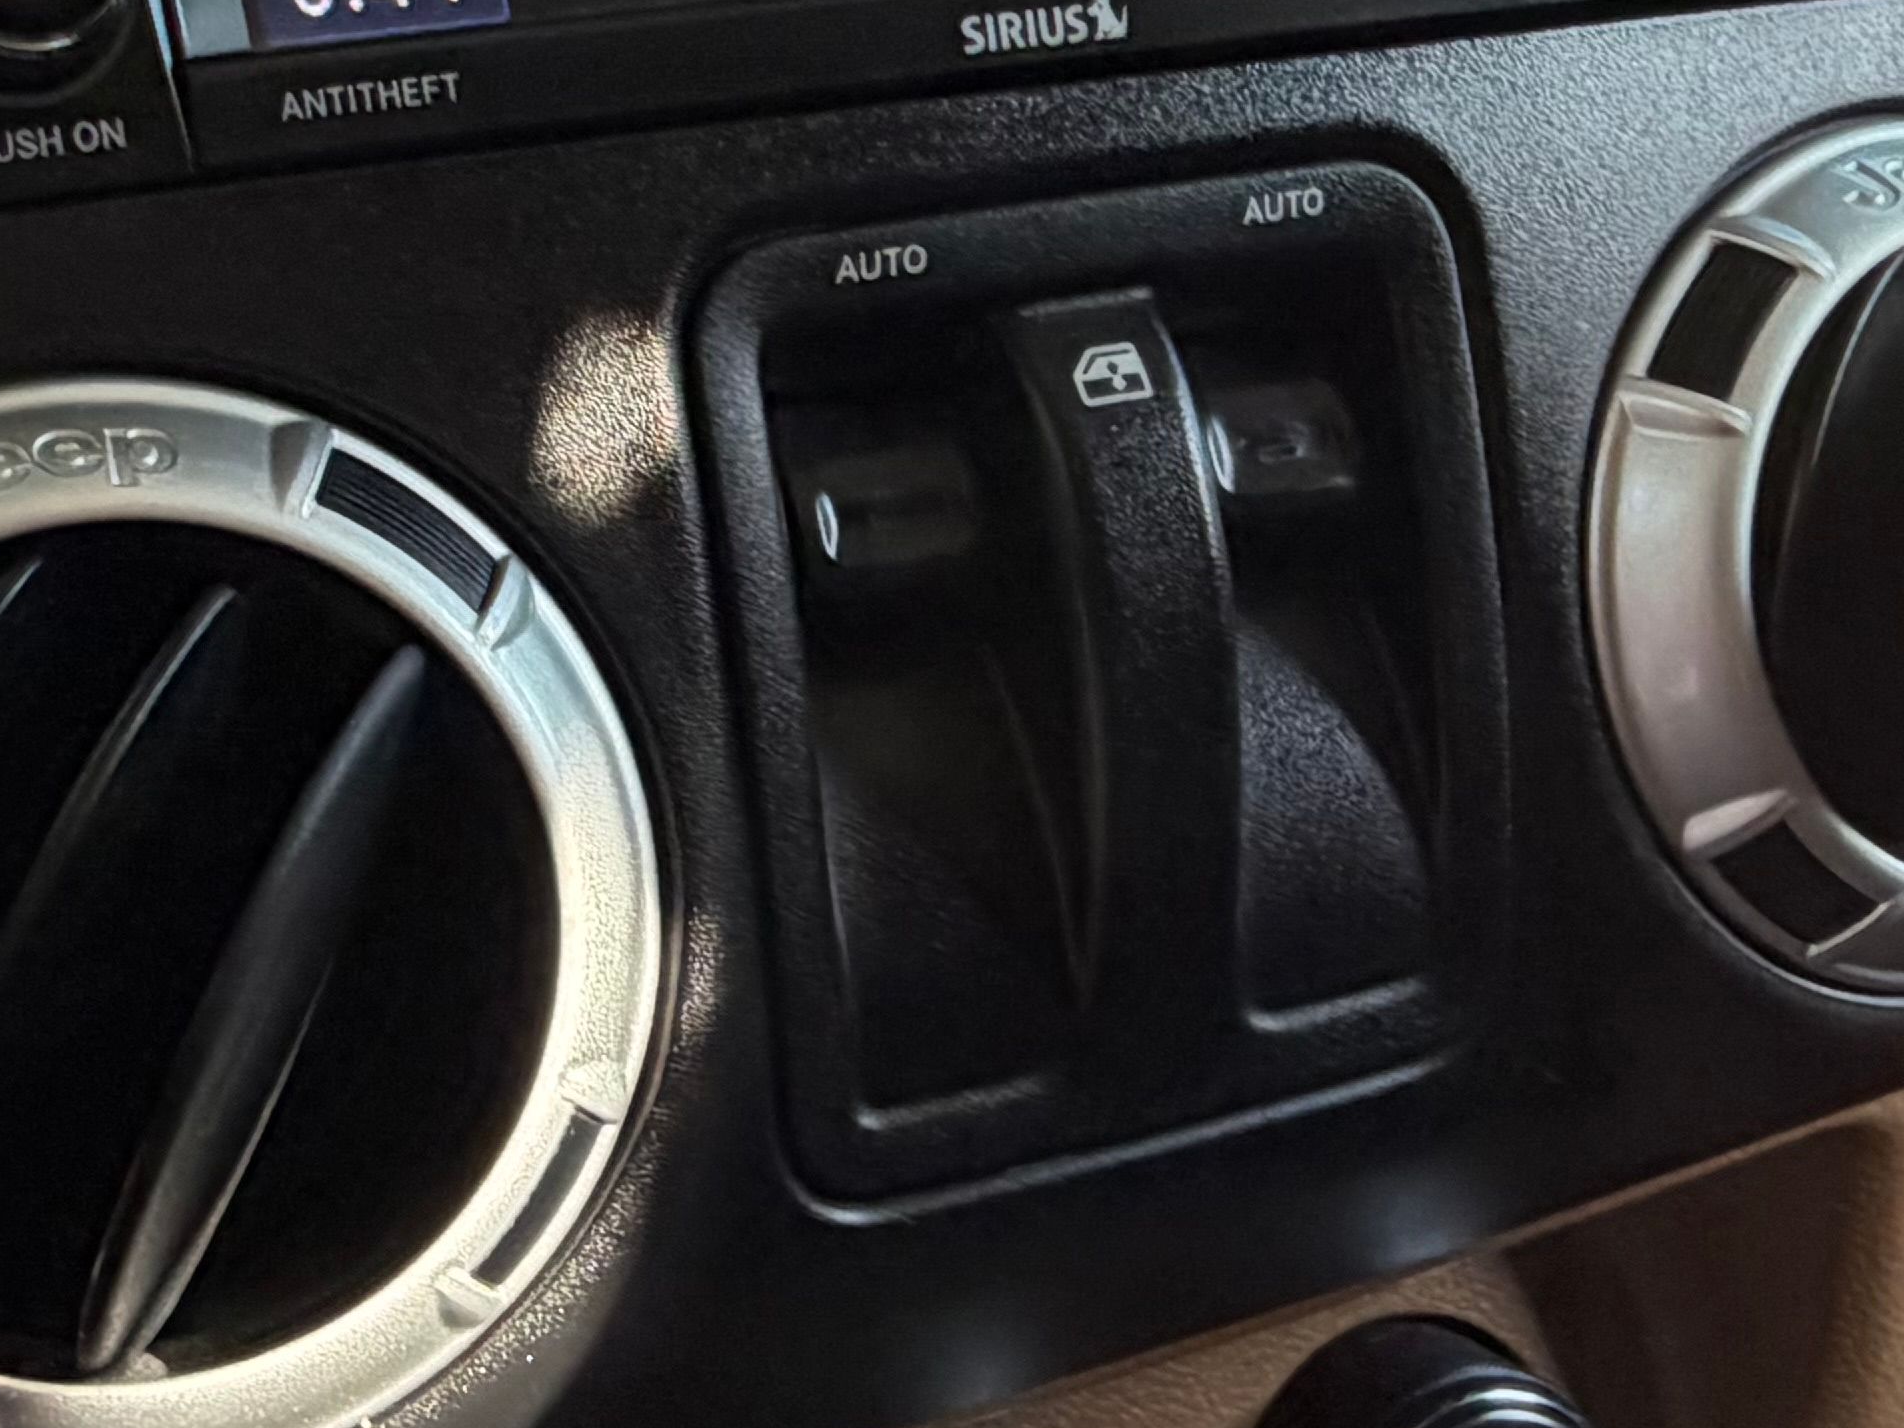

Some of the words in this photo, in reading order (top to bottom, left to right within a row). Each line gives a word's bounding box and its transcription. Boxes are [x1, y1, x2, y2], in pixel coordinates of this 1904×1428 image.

[960, 2, 1092, 56] SIRIUS
[281, 71, 462, 123] ANTITHEFT
[71, 117, 128, 152] ON
[1243, 187, 1326, 227] AUTO
[835, 243, 929, 286] AUTO
